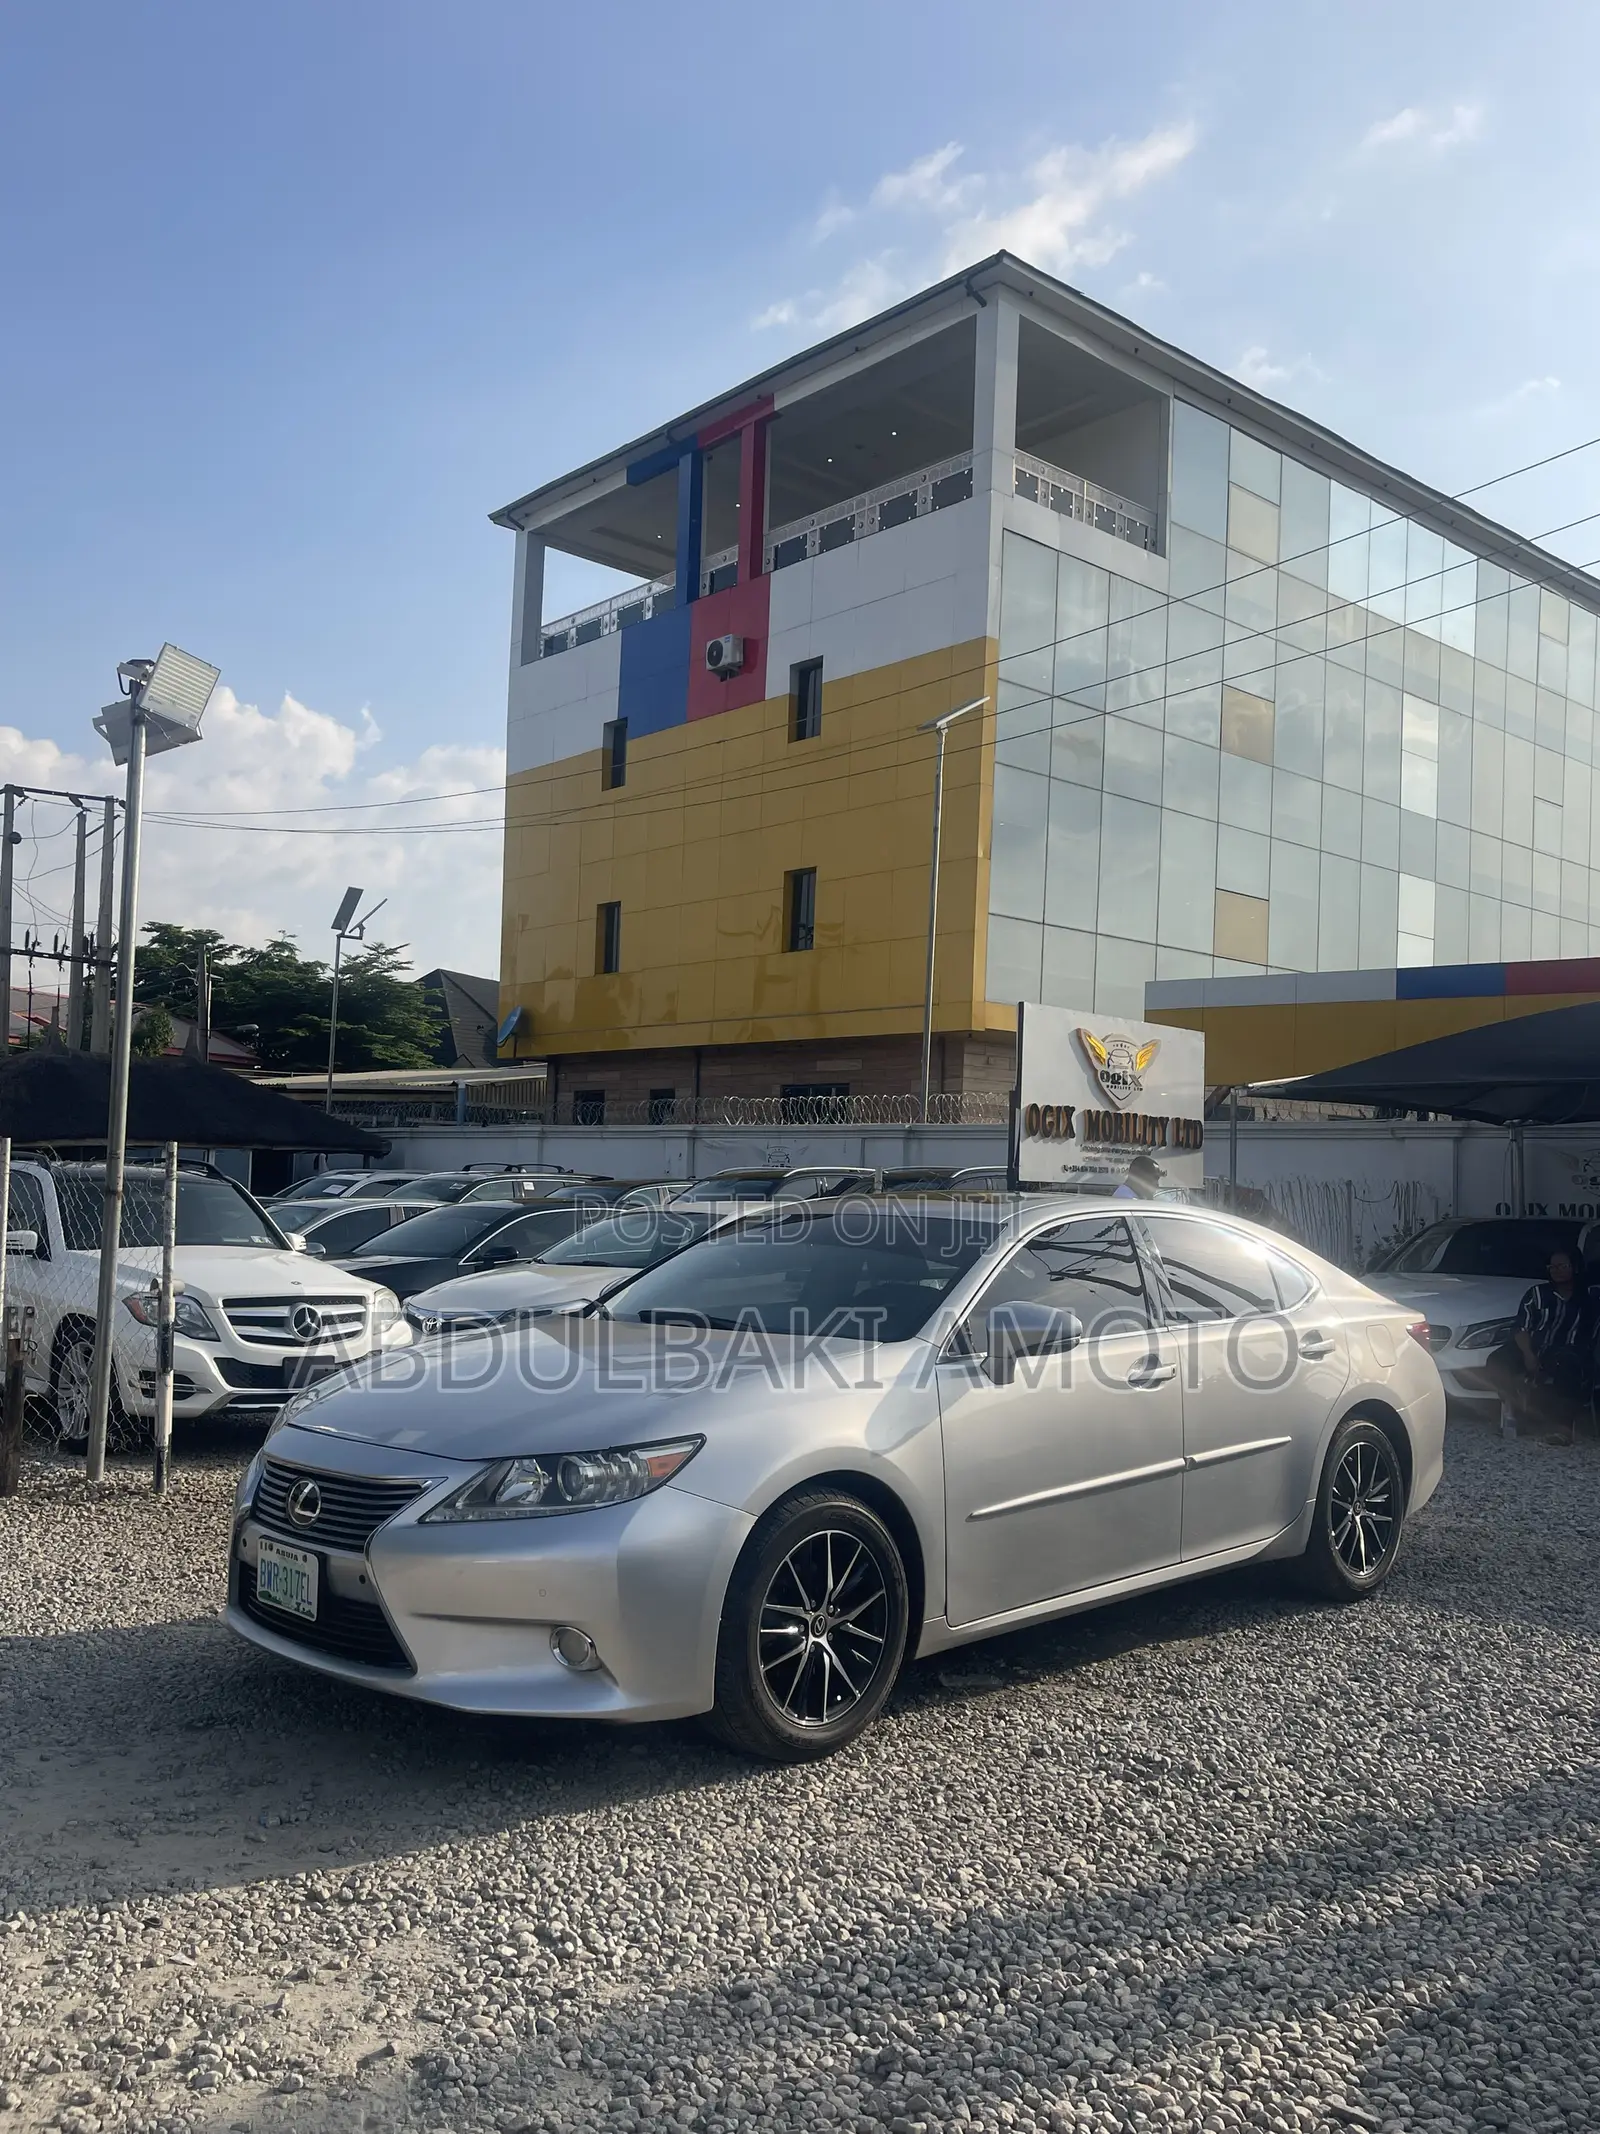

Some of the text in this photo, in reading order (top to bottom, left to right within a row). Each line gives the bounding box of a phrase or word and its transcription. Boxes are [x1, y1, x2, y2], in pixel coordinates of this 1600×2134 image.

[1026, 1103, 1204, 1149] OGIX MOBILITY LTD
[1495, 1202, 1600, 1217] OIX MO
